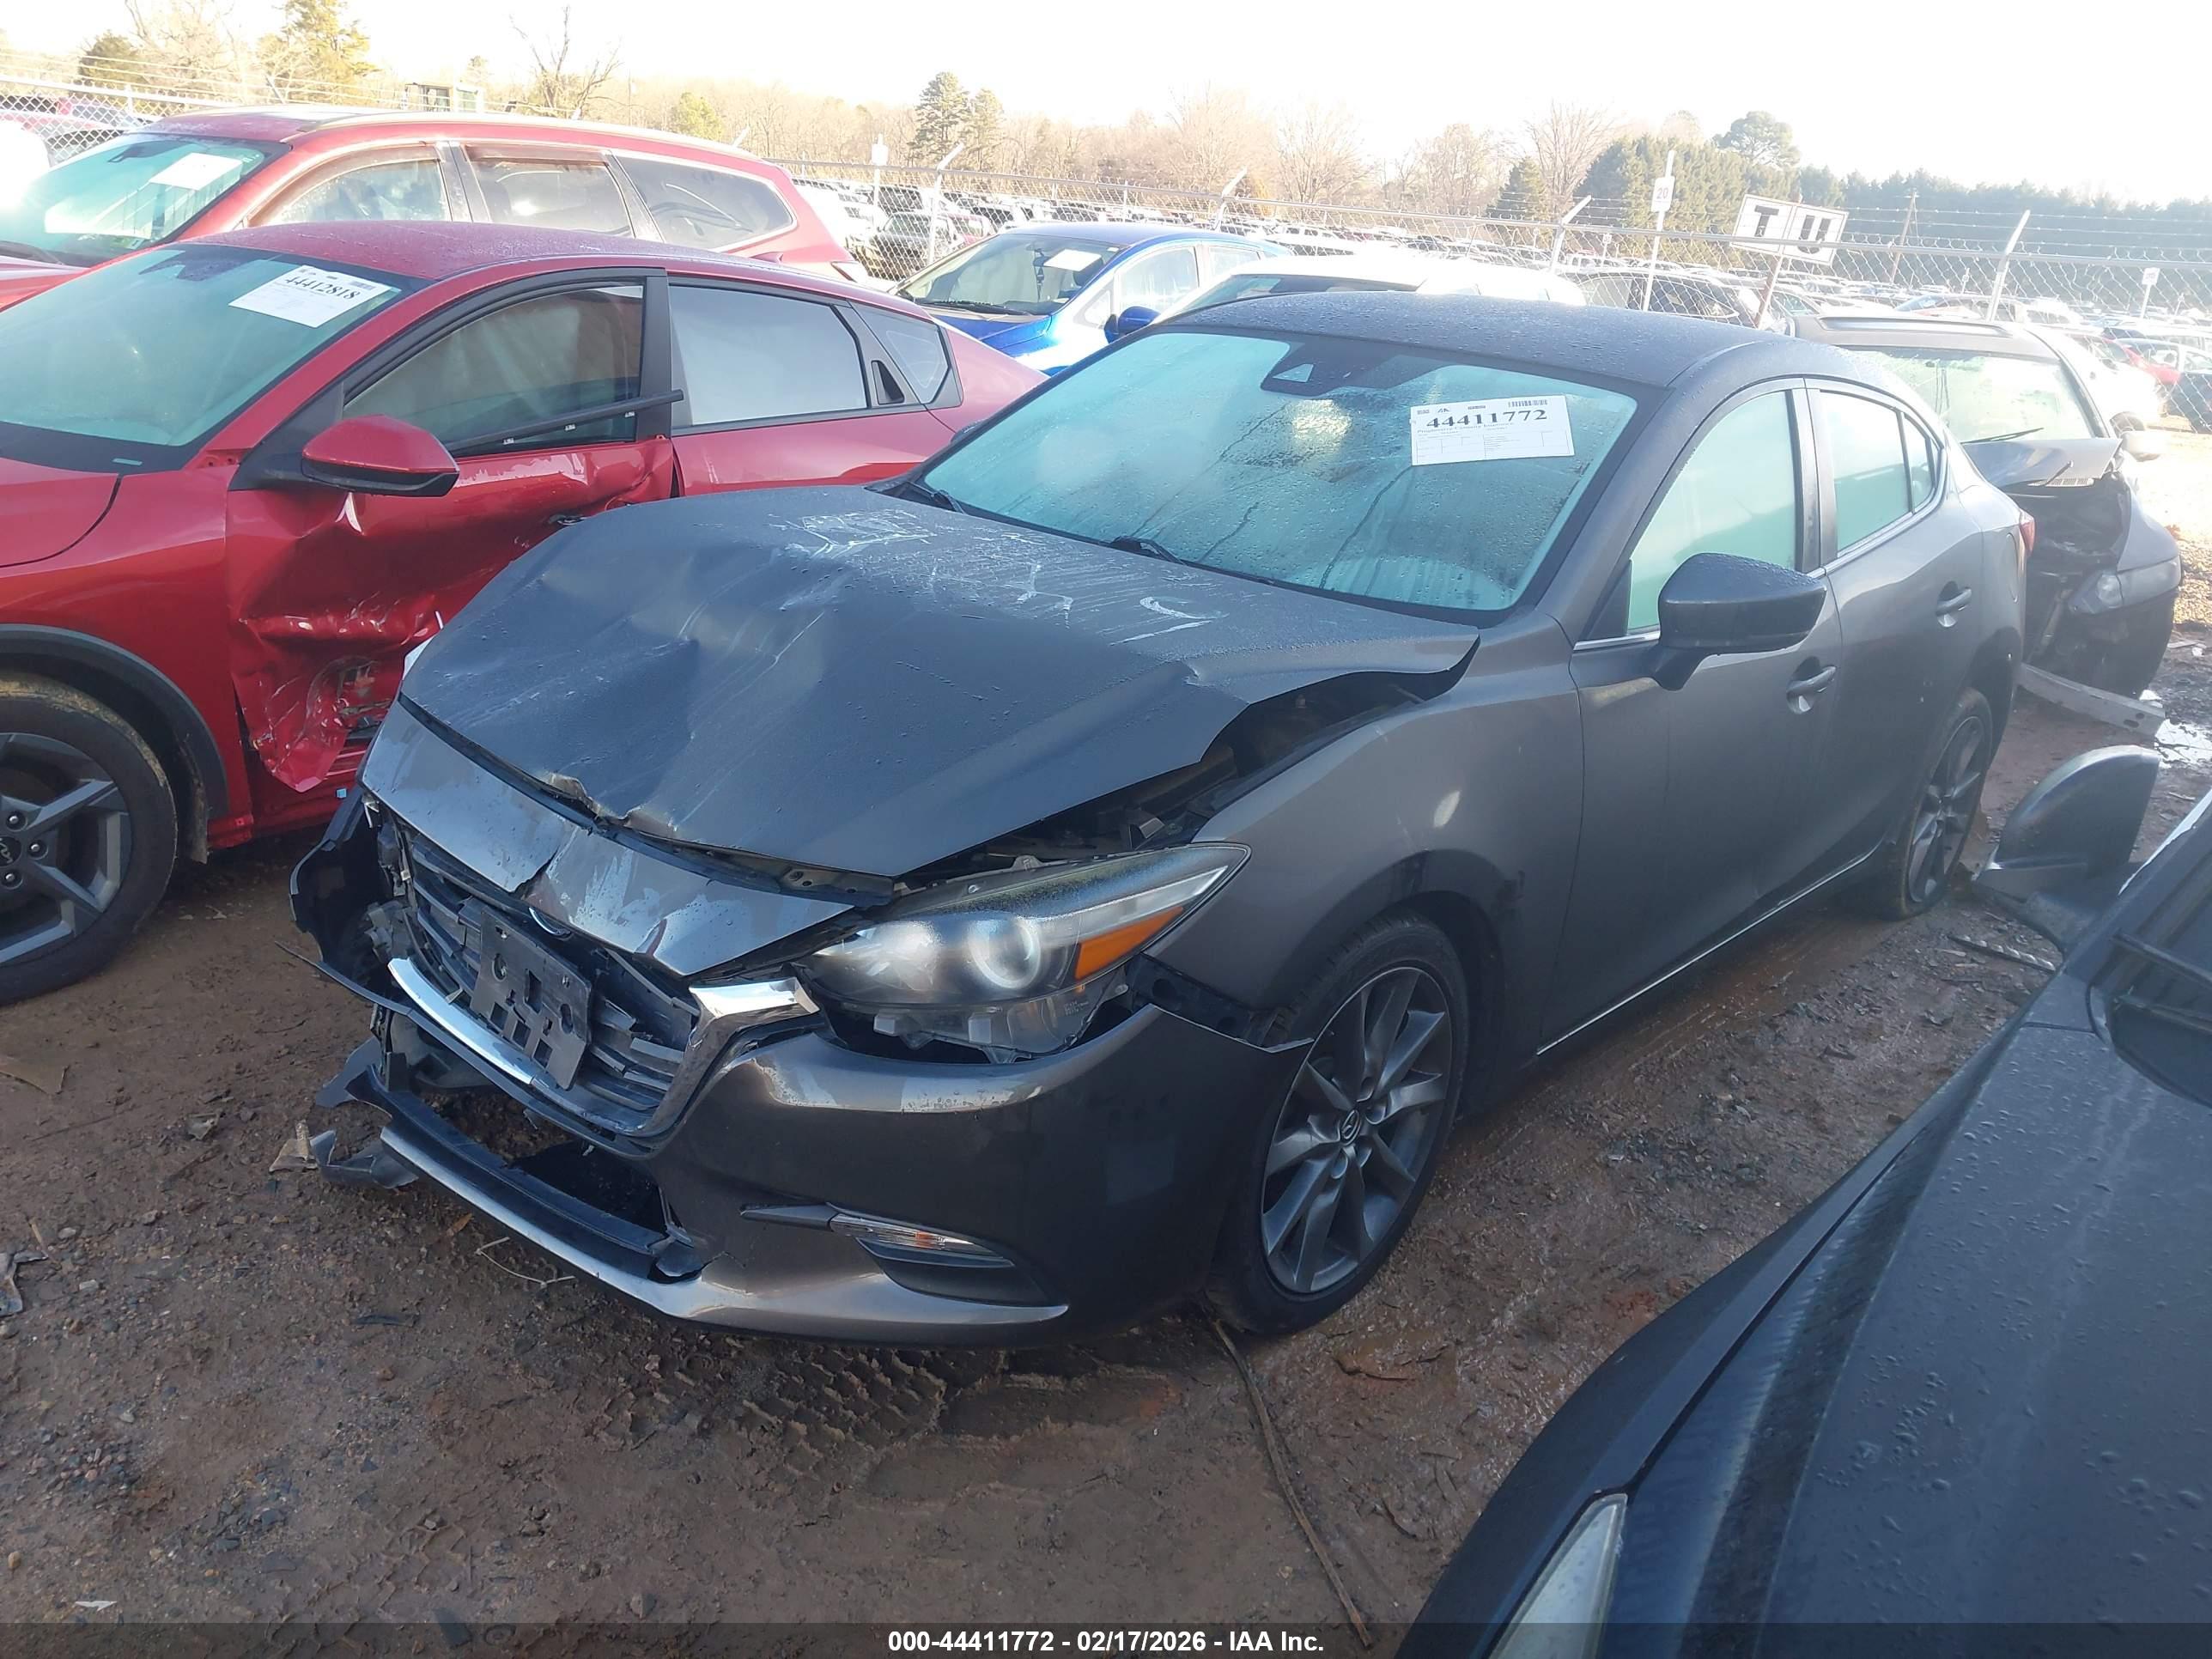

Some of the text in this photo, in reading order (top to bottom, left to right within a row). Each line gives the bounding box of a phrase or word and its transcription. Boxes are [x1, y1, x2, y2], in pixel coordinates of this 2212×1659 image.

[1656, 186, 1669, 199] 20
[1754, 204, 1832, 255] T U
[284, 276, 362, 300] 44412818
[1426, 409, 1548, 428] 44411772
